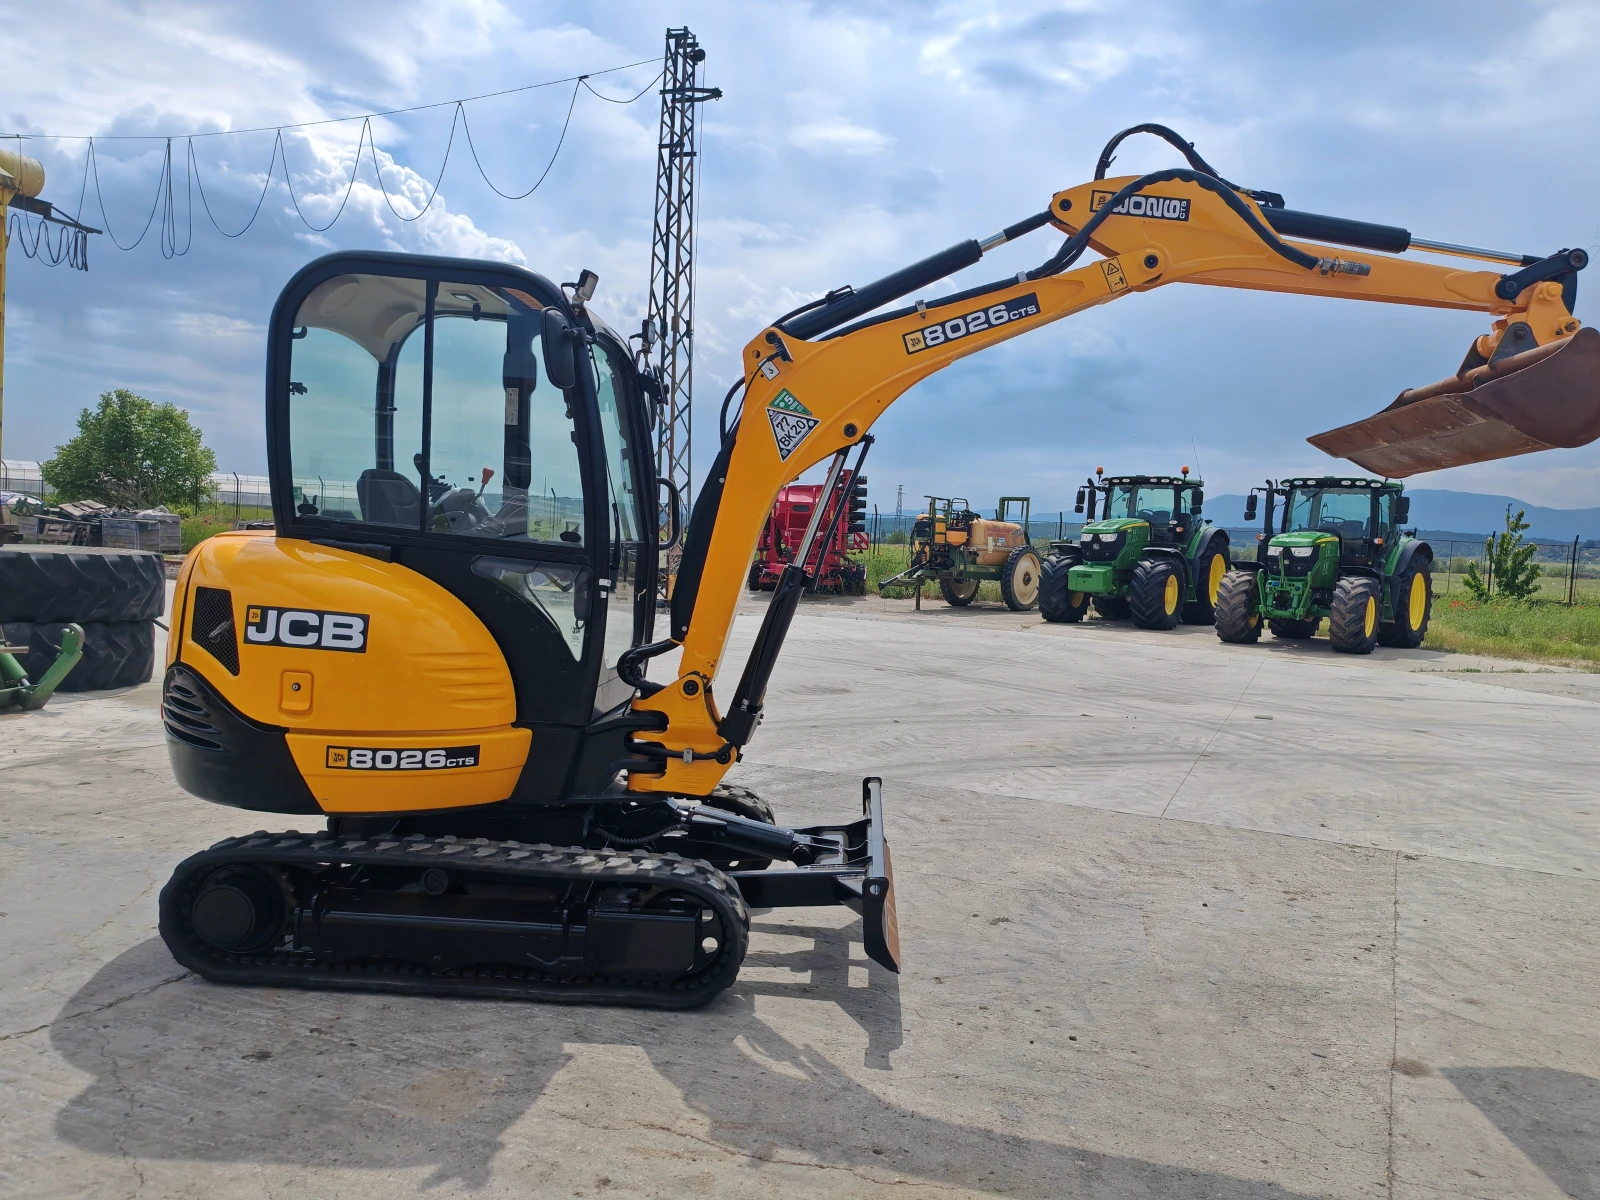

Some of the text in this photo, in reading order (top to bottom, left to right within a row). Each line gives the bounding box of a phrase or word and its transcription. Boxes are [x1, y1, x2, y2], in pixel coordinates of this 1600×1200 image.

[783, 394, 794, 405] 5
[775, 416, 791, 433] 77
[779, 420, 806, 448] BK20
[247, 609, 365, 649] JCB
